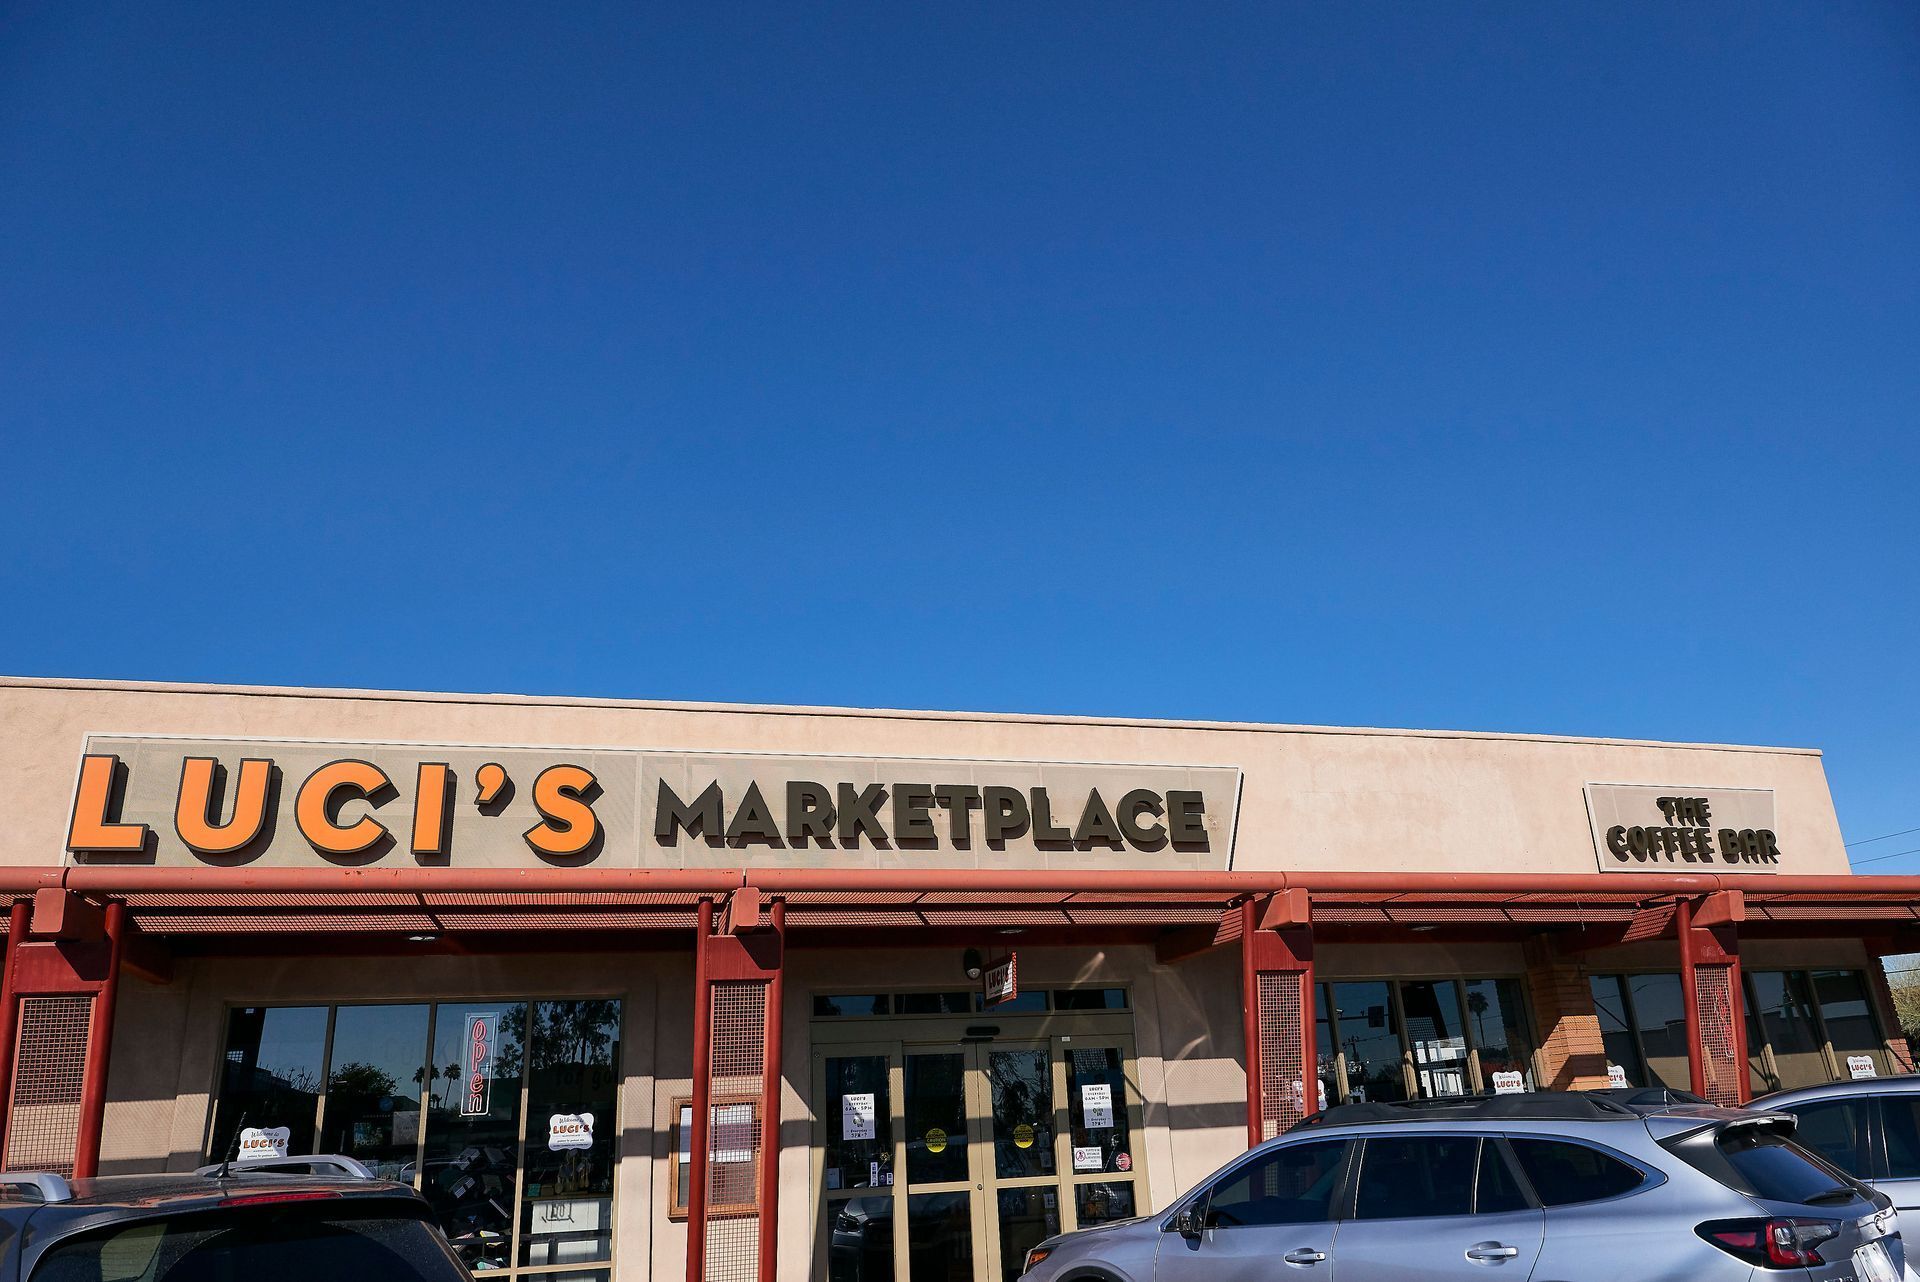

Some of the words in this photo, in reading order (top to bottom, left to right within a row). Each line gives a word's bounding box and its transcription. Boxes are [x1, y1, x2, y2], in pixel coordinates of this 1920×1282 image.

[66, 754, 605, 866] LUCI'S
[654, 776, 1211, 853] MARKETPLACE
[1656, 796, 1712, 827] THE
[1606, 825, 1715, 862] COFFEE
[1718, 828, 1781, 864] BAR
[1496, 1080, 1521, 1088] LUCI'S
[553, 1124, 590, 1134] LUCI'S
[243, 1138, 285, 1149] LUCI'S
